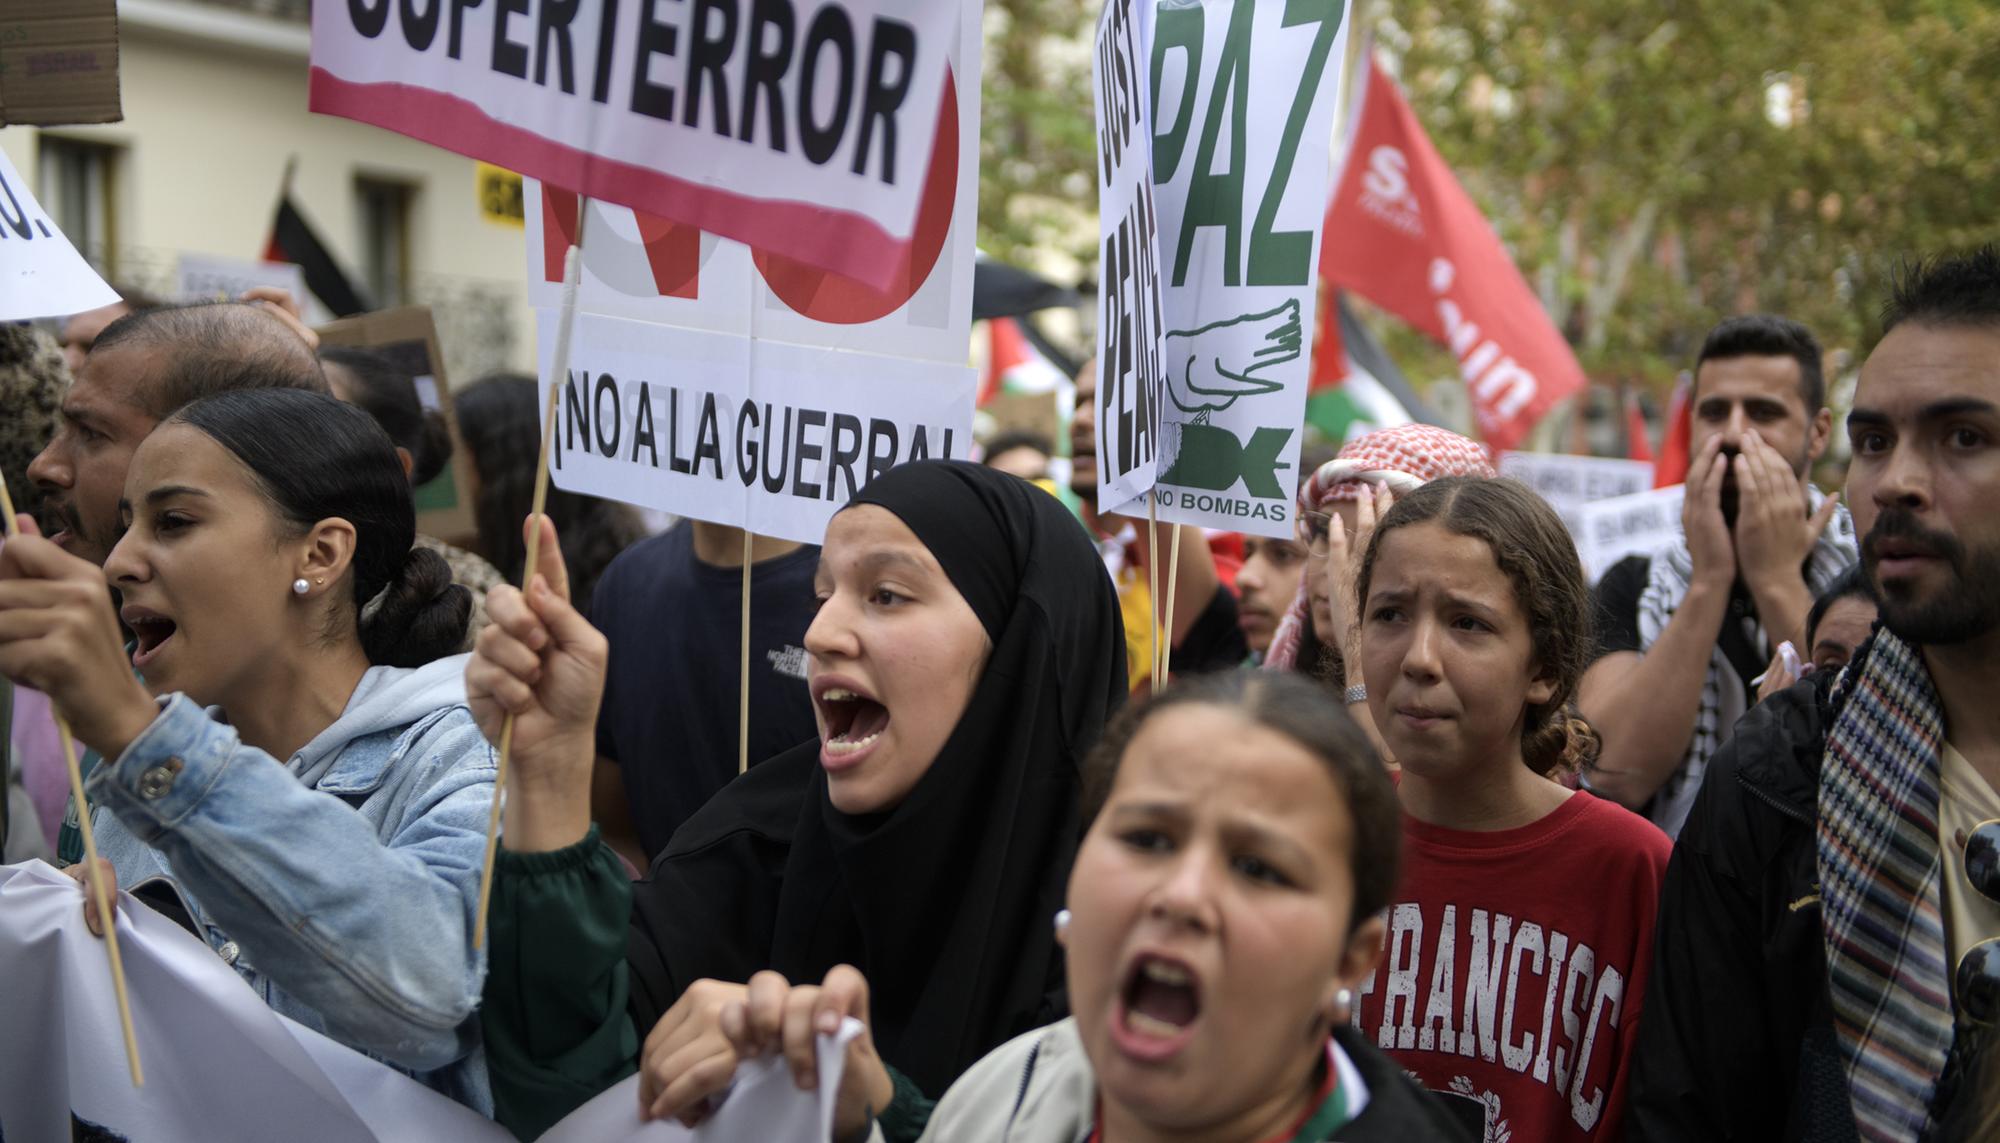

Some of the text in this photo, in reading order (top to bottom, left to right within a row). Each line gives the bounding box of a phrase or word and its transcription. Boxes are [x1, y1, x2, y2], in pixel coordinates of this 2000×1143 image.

[348, 0, 917, 186] ERTERROR
[1150, 0, 1346, 288] PAZ
[632, 381, 659, 468] A
[670, 387, 724, 481] LA
[1180, 493, 1287, 522] BOMBAS
